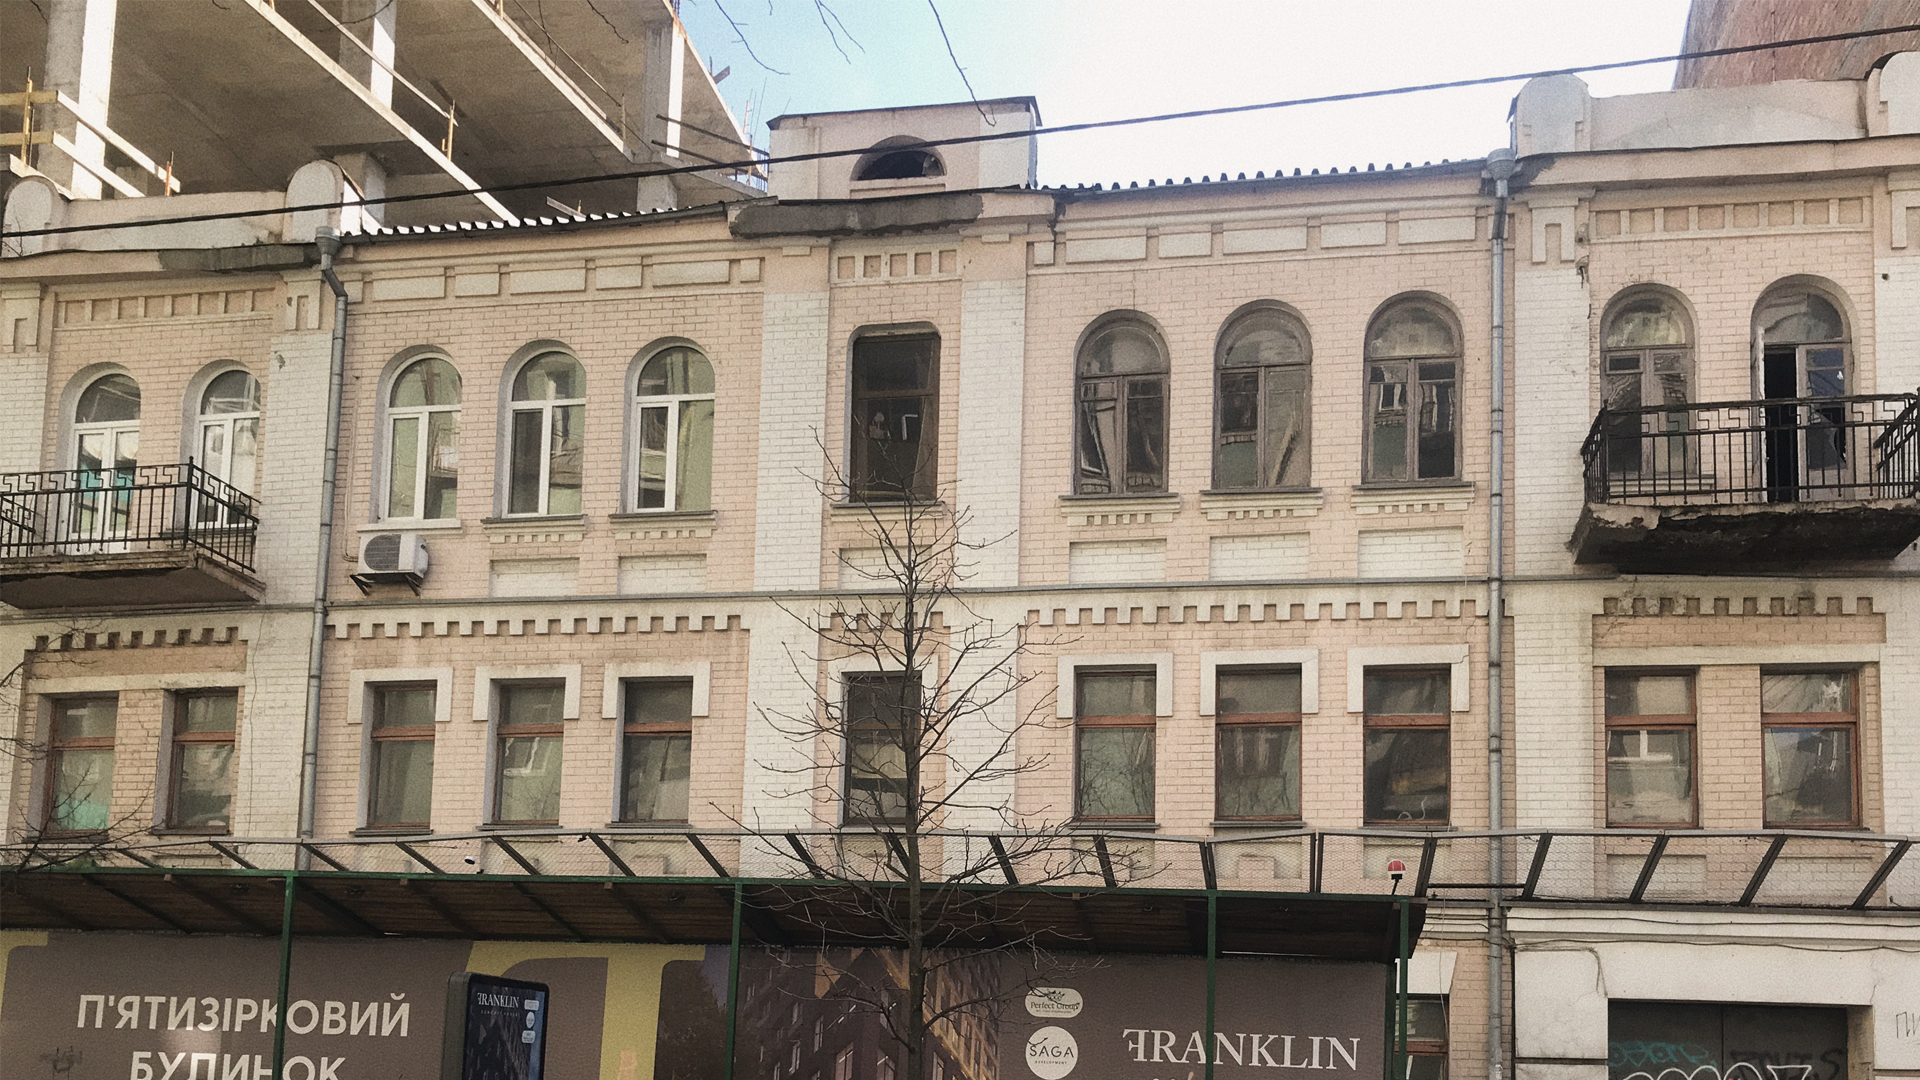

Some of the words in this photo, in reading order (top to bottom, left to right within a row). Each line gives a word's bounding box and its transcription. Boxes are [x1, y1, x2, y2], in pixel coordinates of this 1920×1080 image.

[477, 992, 519, 1008] FRANKLIN
[1031, 1002, 1055, 1010] Perfect
[1056, 1002, 1078, 1011] Group
[77, 992, 410, 1037] П'ЯТИЗІРКОВИЙ
[1029, 1045, 1075, 1058] SAGA
[1122, 1029, 1361, 1071] FRANKLIN
